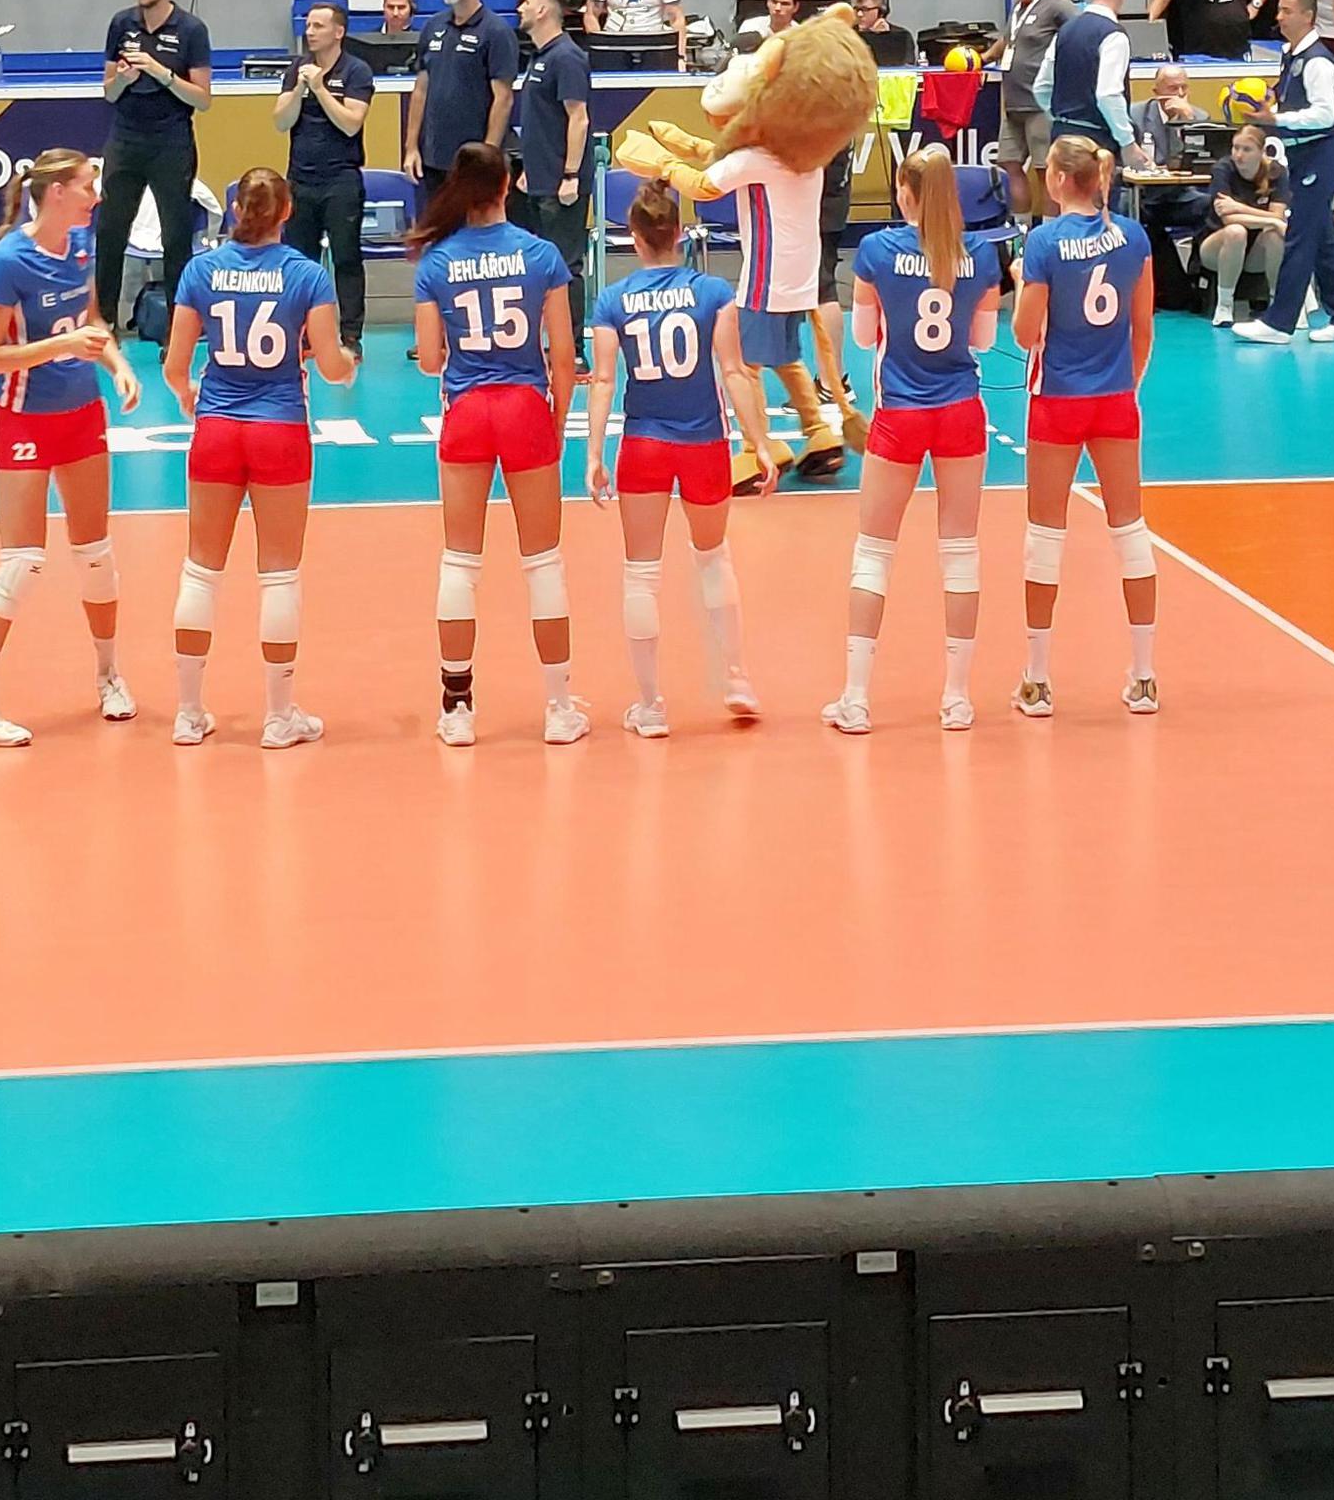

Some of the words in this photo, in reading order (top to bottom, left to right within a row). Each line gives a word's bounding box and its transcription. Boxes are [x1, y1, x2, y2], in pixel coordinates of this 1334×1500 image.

[211, 267, 284, 294] MLEJNKOVÁ
[447, 248, 527, 284] JEHLÁŘOVÁ
[1083, 263, 1119, 326] 6
[210, 299, 287, 369] 16
[453, 285, 529, 352] 15
[624, 311, 699, 381] 10
[913, 287, 954, 353] 8
[10, 441, 39, 462] 22
